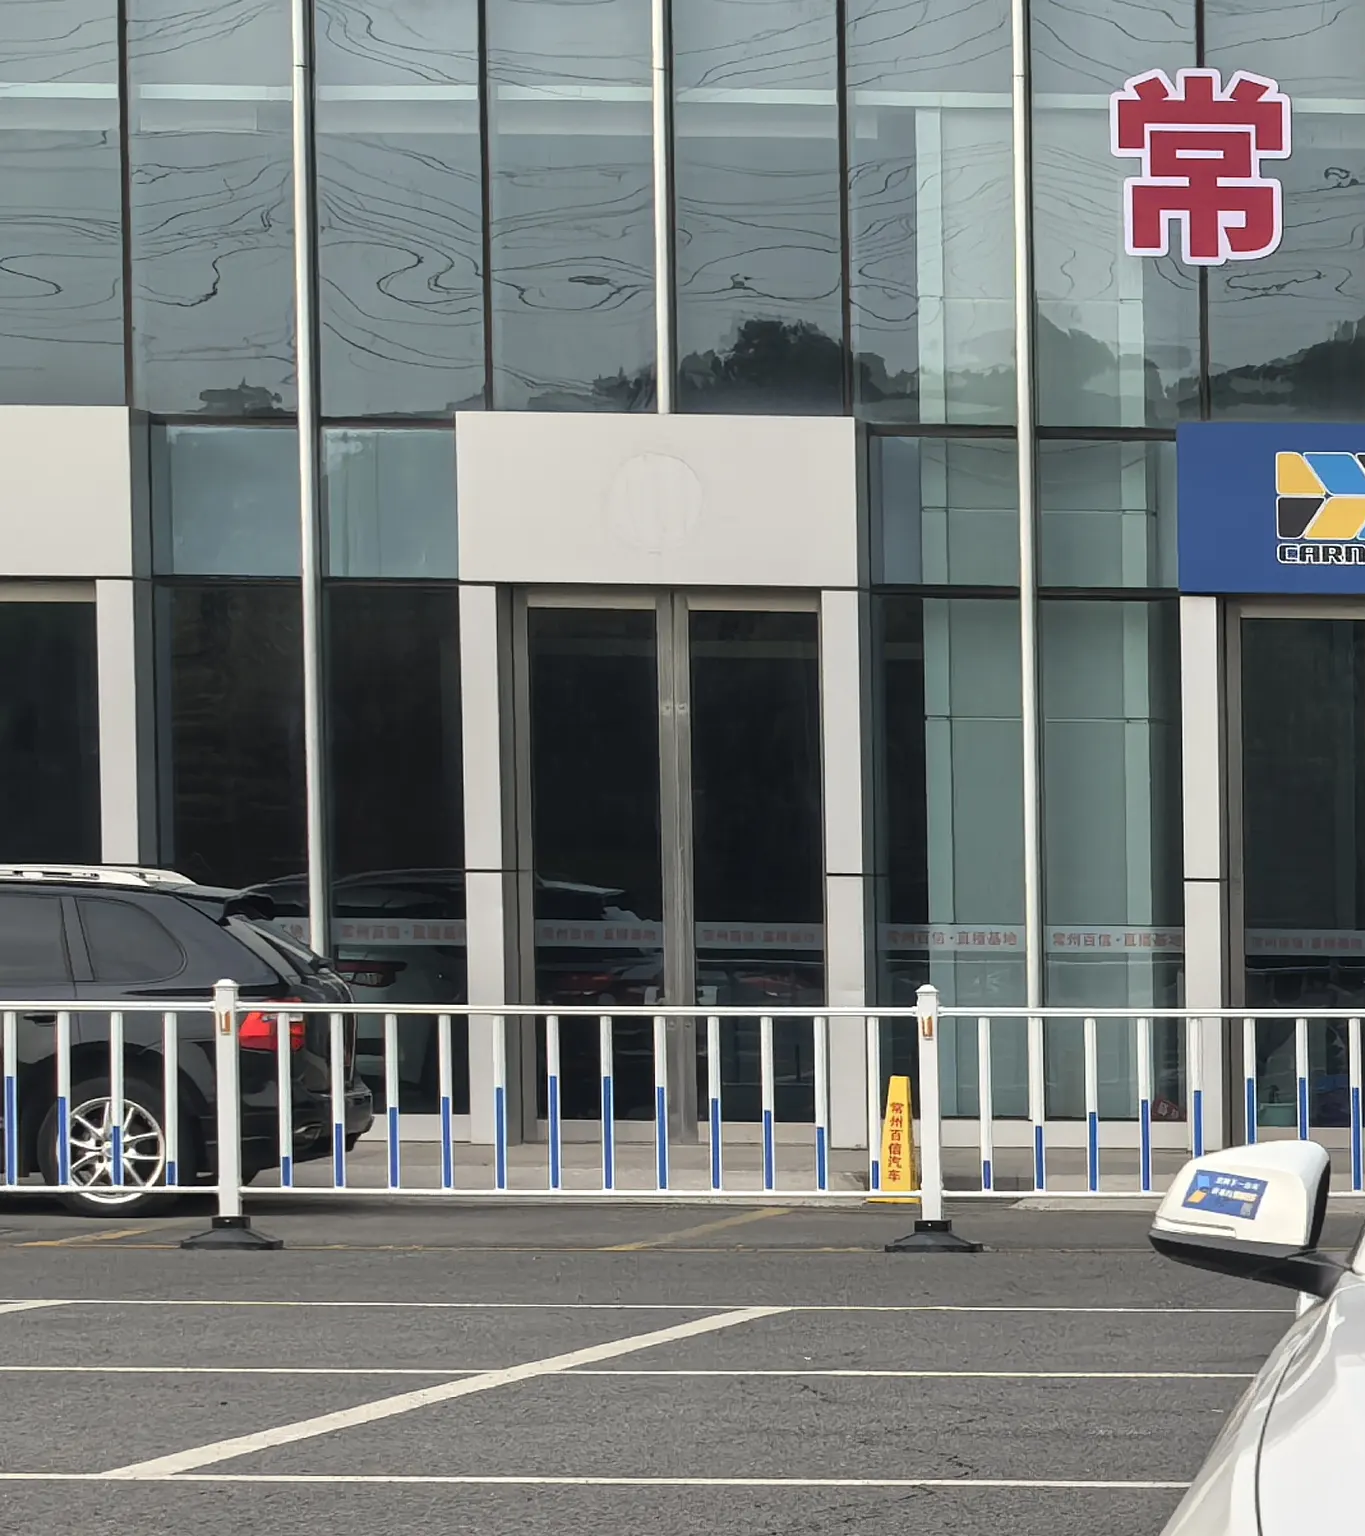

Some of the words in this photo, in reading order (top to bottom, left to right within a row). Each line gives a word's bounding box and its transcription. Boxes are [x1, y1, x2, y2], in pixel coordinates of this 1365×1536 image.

[888, 1102, 904, 1182] 常州百信汽车
